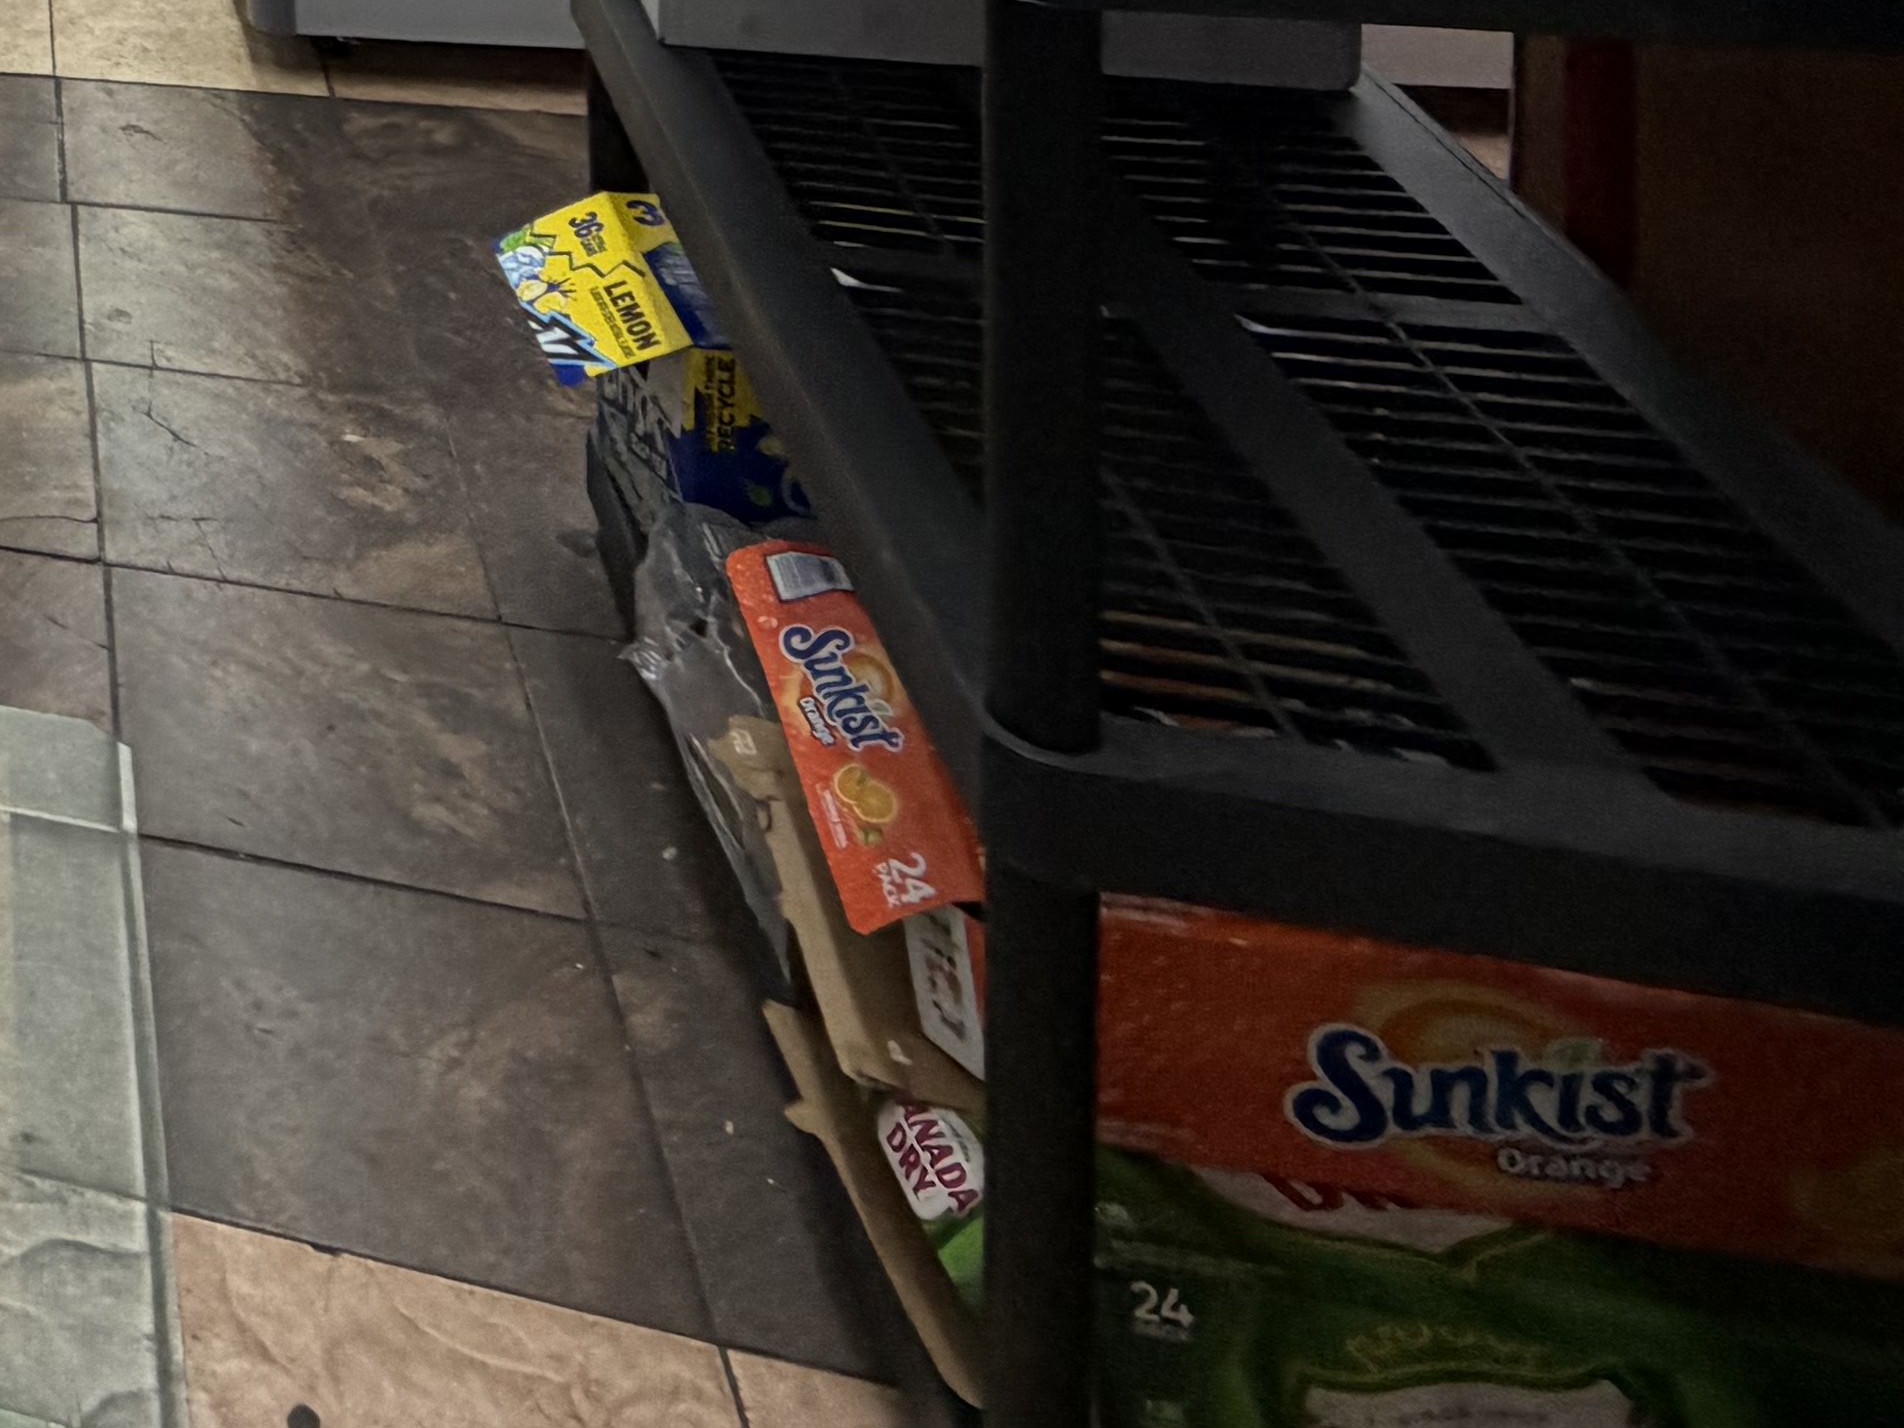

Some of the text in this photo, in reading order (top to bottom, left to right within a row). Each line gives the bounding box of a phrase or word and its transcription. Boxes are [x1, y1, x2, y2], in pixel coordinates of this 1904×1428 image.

[602, 279, 663, 352] LEMON
[780, 625, 904, 754] Sunkist
[800, 696, 836, 746] Orange
[885, 852, 937, 904] 24
[1286, 1022, 1715, 1147] Sunkist
[886, 1122, 937, 1199] DRY
[895, 1099, 981, 1217] ANADA
[1498, 1148, 1652, 1190] Orange
[1130, 1280, 1192, 1326] 24
